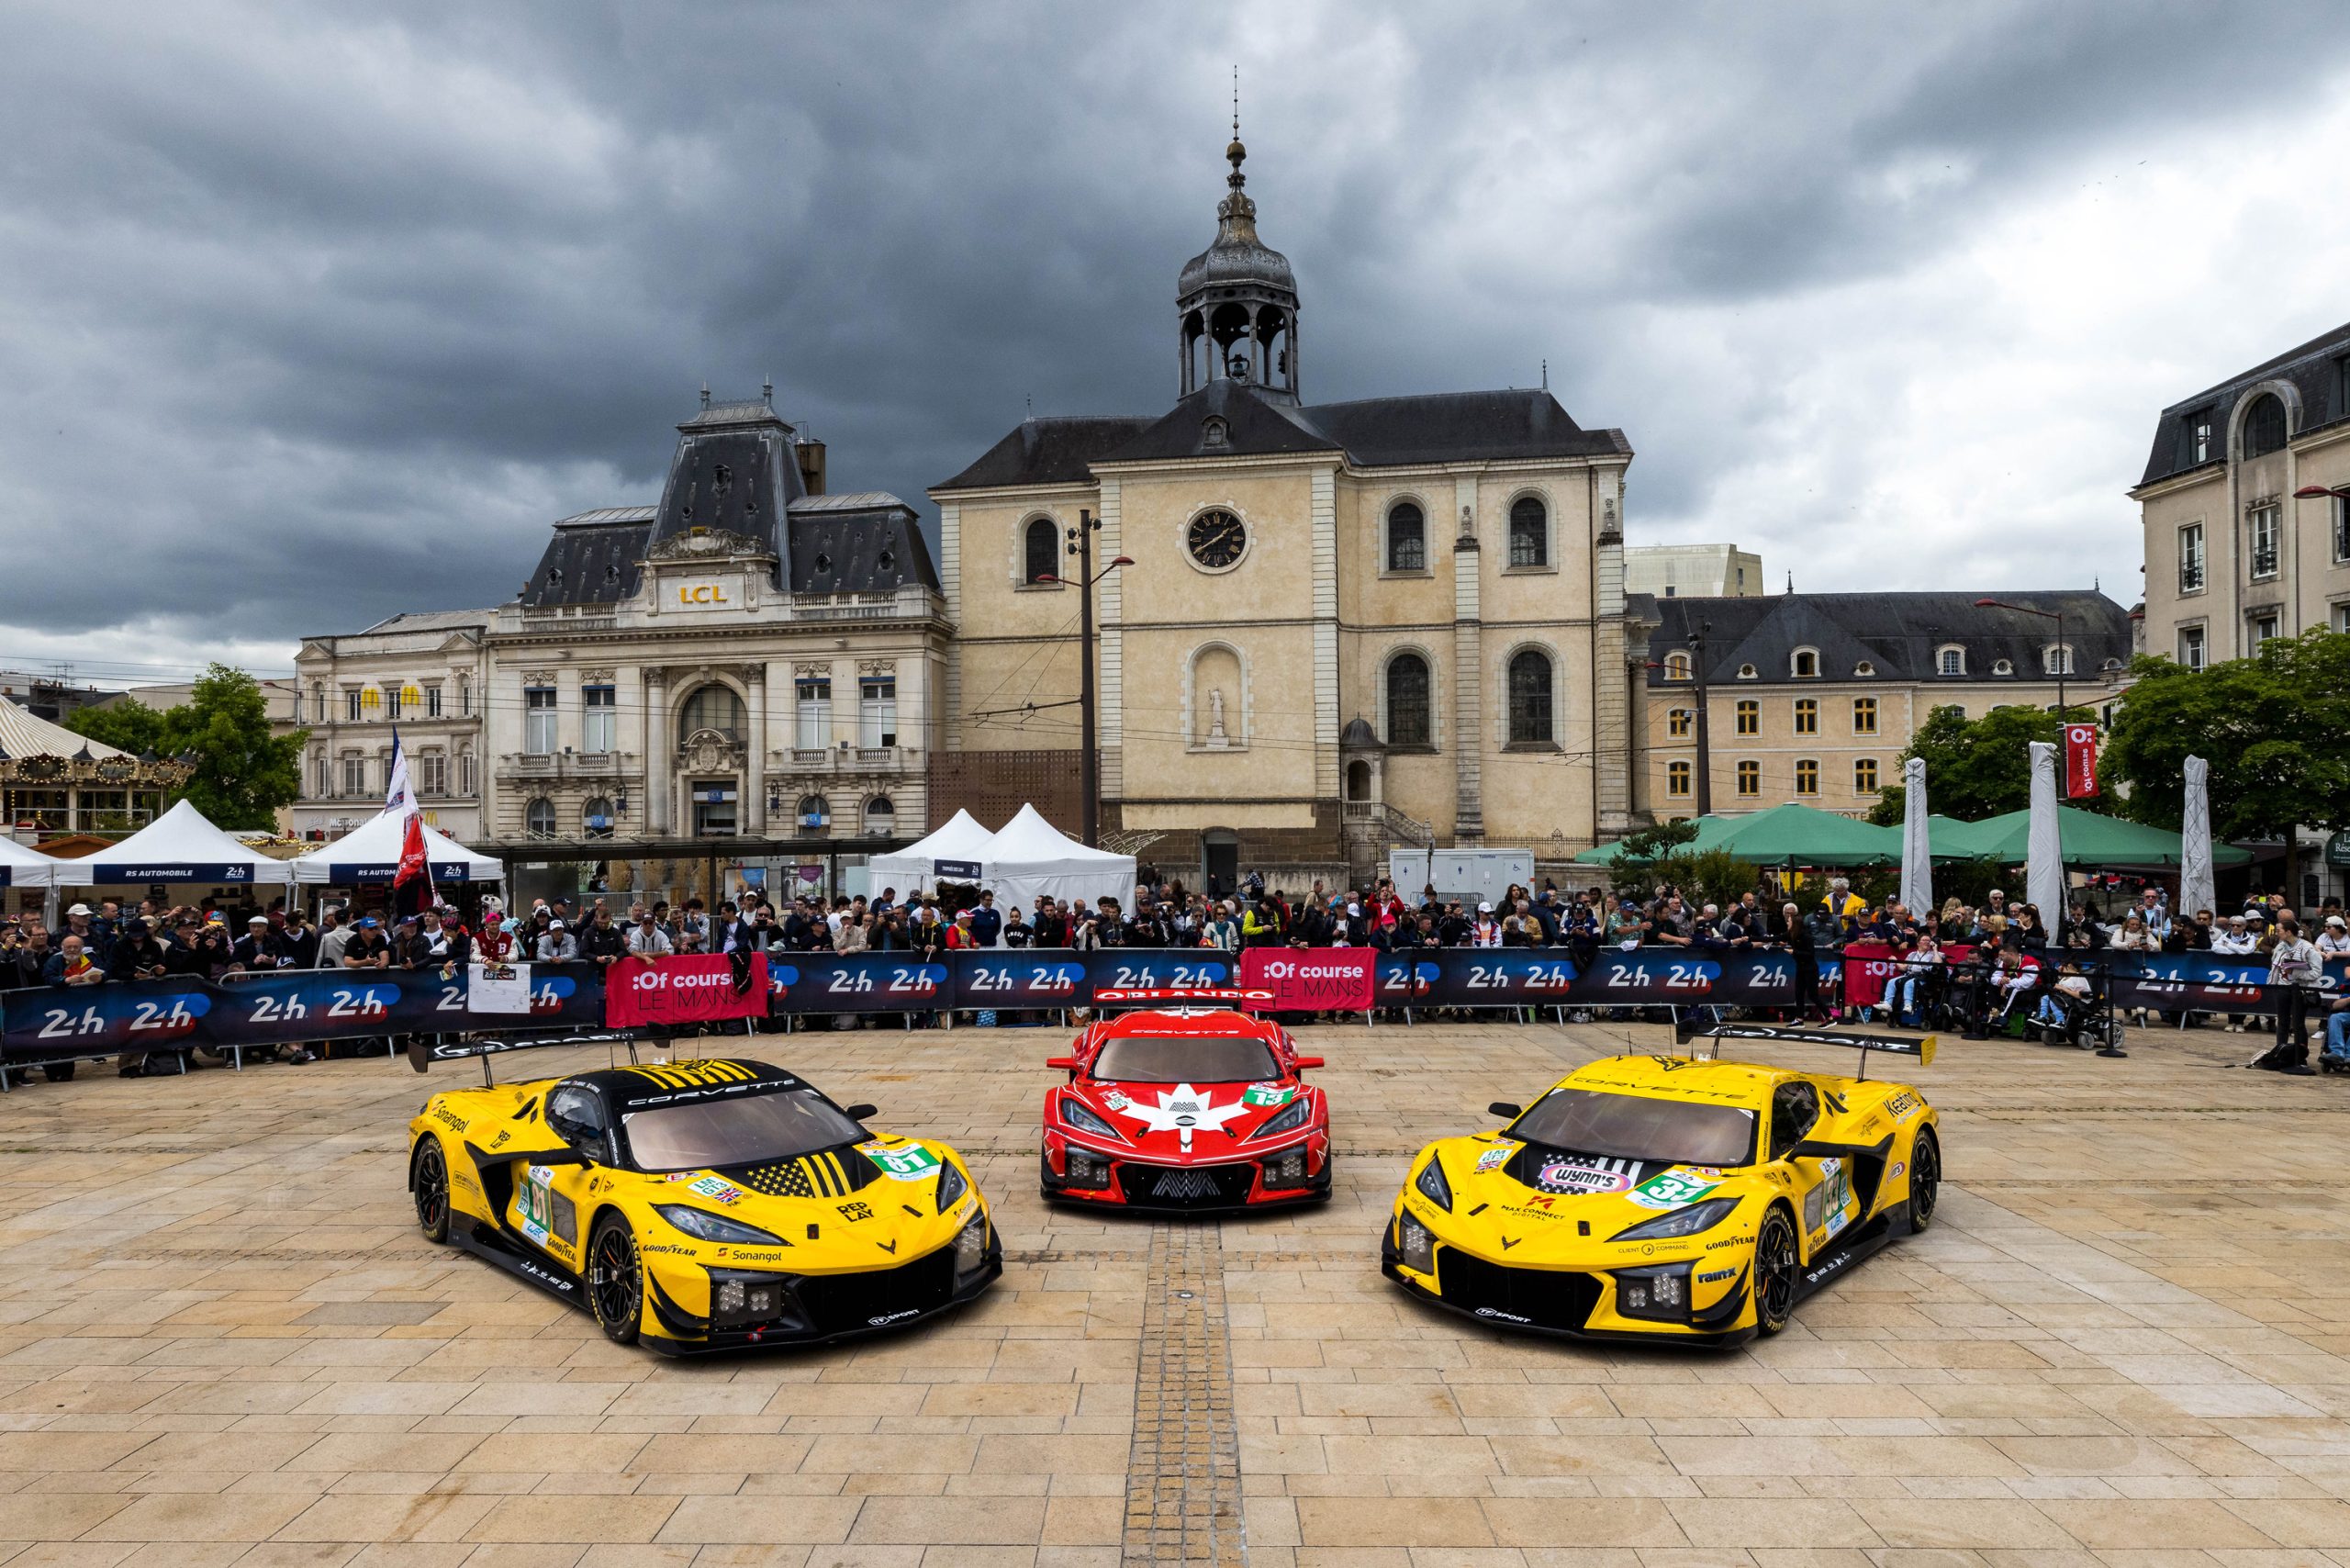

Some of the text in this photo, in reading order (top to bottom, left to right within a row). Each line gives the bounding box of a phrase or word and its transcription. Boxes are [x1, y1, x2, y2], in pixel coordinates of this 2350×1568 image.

[680, 586, 728, 603] LCL
[226, 867, 245, 876] 24h
[445, 866, 462, 874] 24h
[498, 943, 507, 954] B
[673, 973, 734, 988] cours
[829, 969, 873, 992] 24h
[889, 969, 933, 991] 24h
[969, 968, 1013, 991] 24h
[1029, 968, 1071, 990] 24h
[1113, 967, 1155, 989] 24h
[1169, 967, 1212, 989] 24h
[1300, 965, 1363, 978] course
[1467, 966, 1509, 988] 24h
[1524, 966, 1566, 988] 24h
[1607, 965, 1651, 987] 24h
[1666, 965, 1707, 987] 24h
[1749, 965, 1786, 987] 24h
[1096, 991, 1273, 999] ORLANDO
[1304, 980, 1363, 997] MANS
[249, 993, 306, 1022] 24h
[328, 990, 383, 1016] 24h
[638, 991, 666, 1010] LE
[39, 1006, 104, 1038] 24h
[129, 1001, 191, 1030] 24h
[628, 1079, 796, 1107] CORVETTE
[1573, 1077, 1749, 1100] CORVETTE
[1254, 1092, 1283, 1105] 13
[1883, 1089, 1922, 1118] Keating
[433, 1105, 470, 1134] Sonangol
[882, 1153, 928, 1173] 81
[1482, 1154, 1505, 1162] GT3
[693, 1178, 715, 1189] LM
[701, 1182, 729, 1197] GT3
[1648, 1179, 1700, 1202] 33
[532, 1182, 547, 1226] 81
[835, 1201, 868, 1215] REP
[1500, 1204, 1566, 1221] MAX CONNECT
[845, 1209, 875, 1223] LAY
[1512, 1213, 1547, 1222] DIGITAL
[643, 1244, 697, 1257] GOODYEAR
[1655, 1244, 1691, 1252] COMMAND
[1706, 1236, 1755, 1251] GOODYEAR
[732, 1250, 782, 1263] Sonangol
[888, 1309, 920, 1320] SPORT
[1495, 1312, 1531, 1323] SPORT
